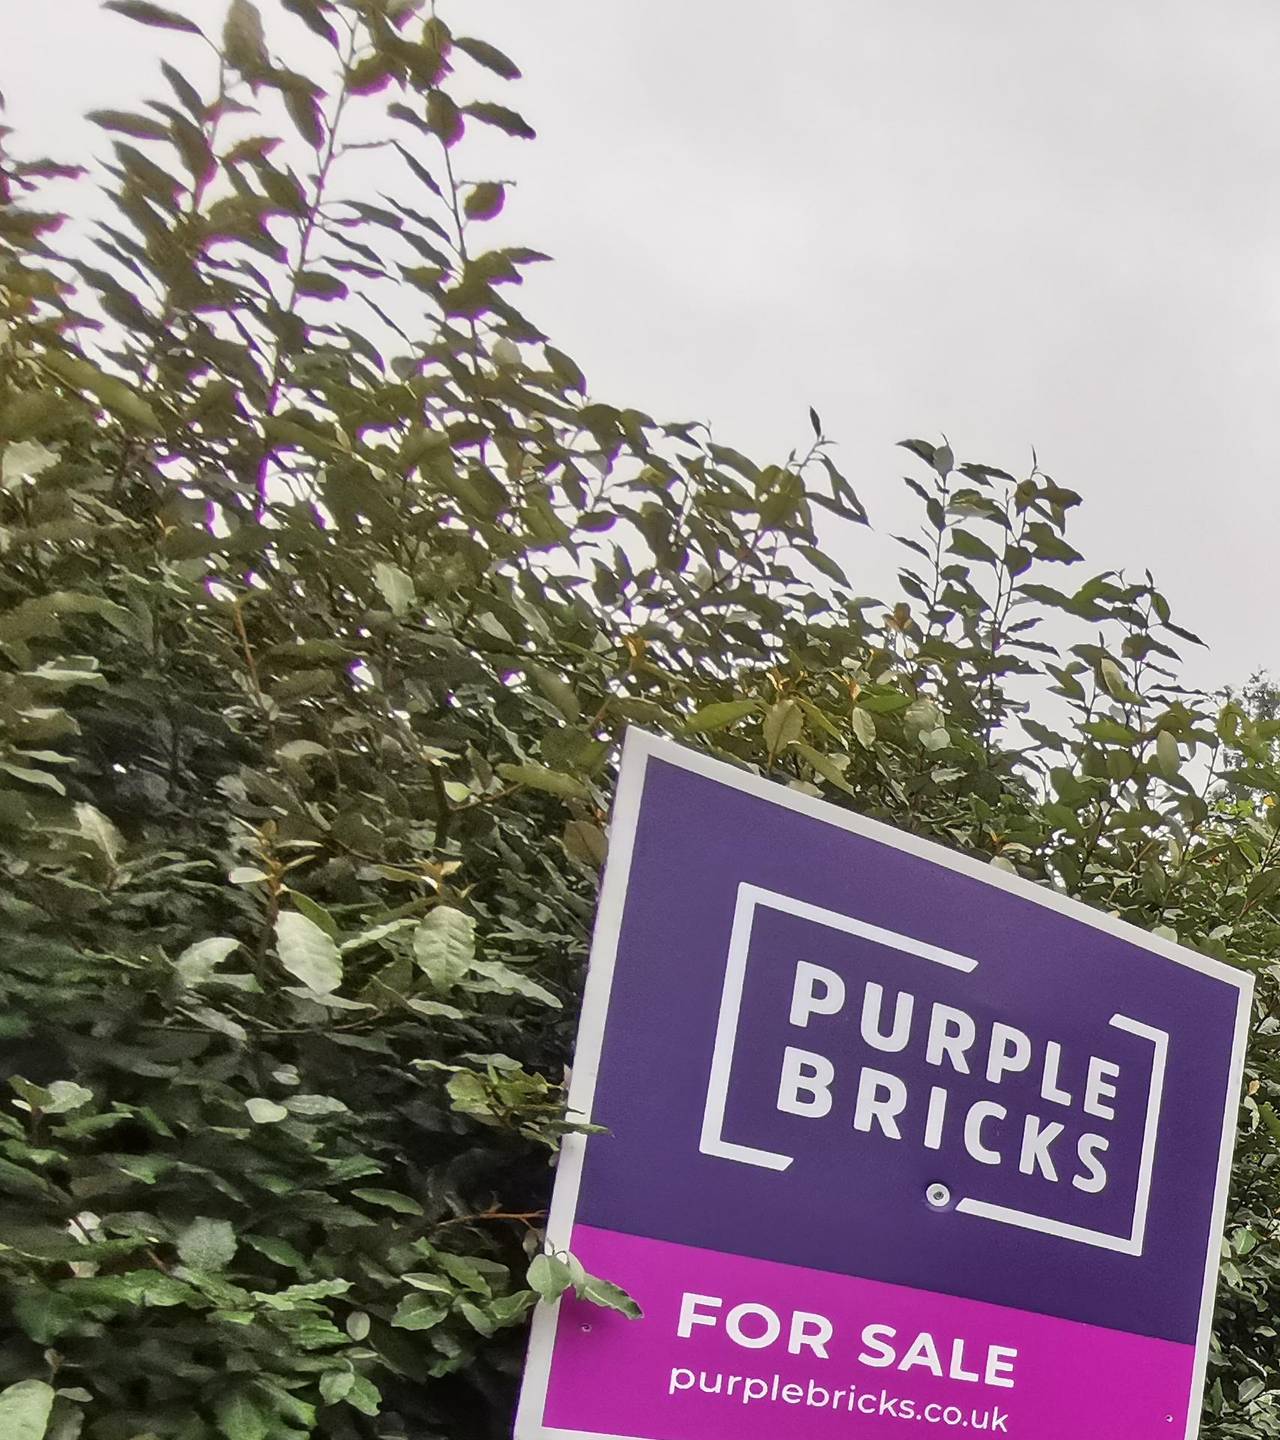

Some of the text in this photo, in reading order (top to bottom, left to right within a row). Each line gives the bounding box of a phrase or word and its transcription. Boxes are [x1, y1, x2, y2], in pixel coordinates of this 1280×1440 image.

[789, 960, 1120, 1121] PURPLE
[776, 1045, 1110, 1194] BRICKS
[668, 1366, 1009, 1433] purplebricks.co.uk
[676, 1292, 1018, 1389] FOR SALE
